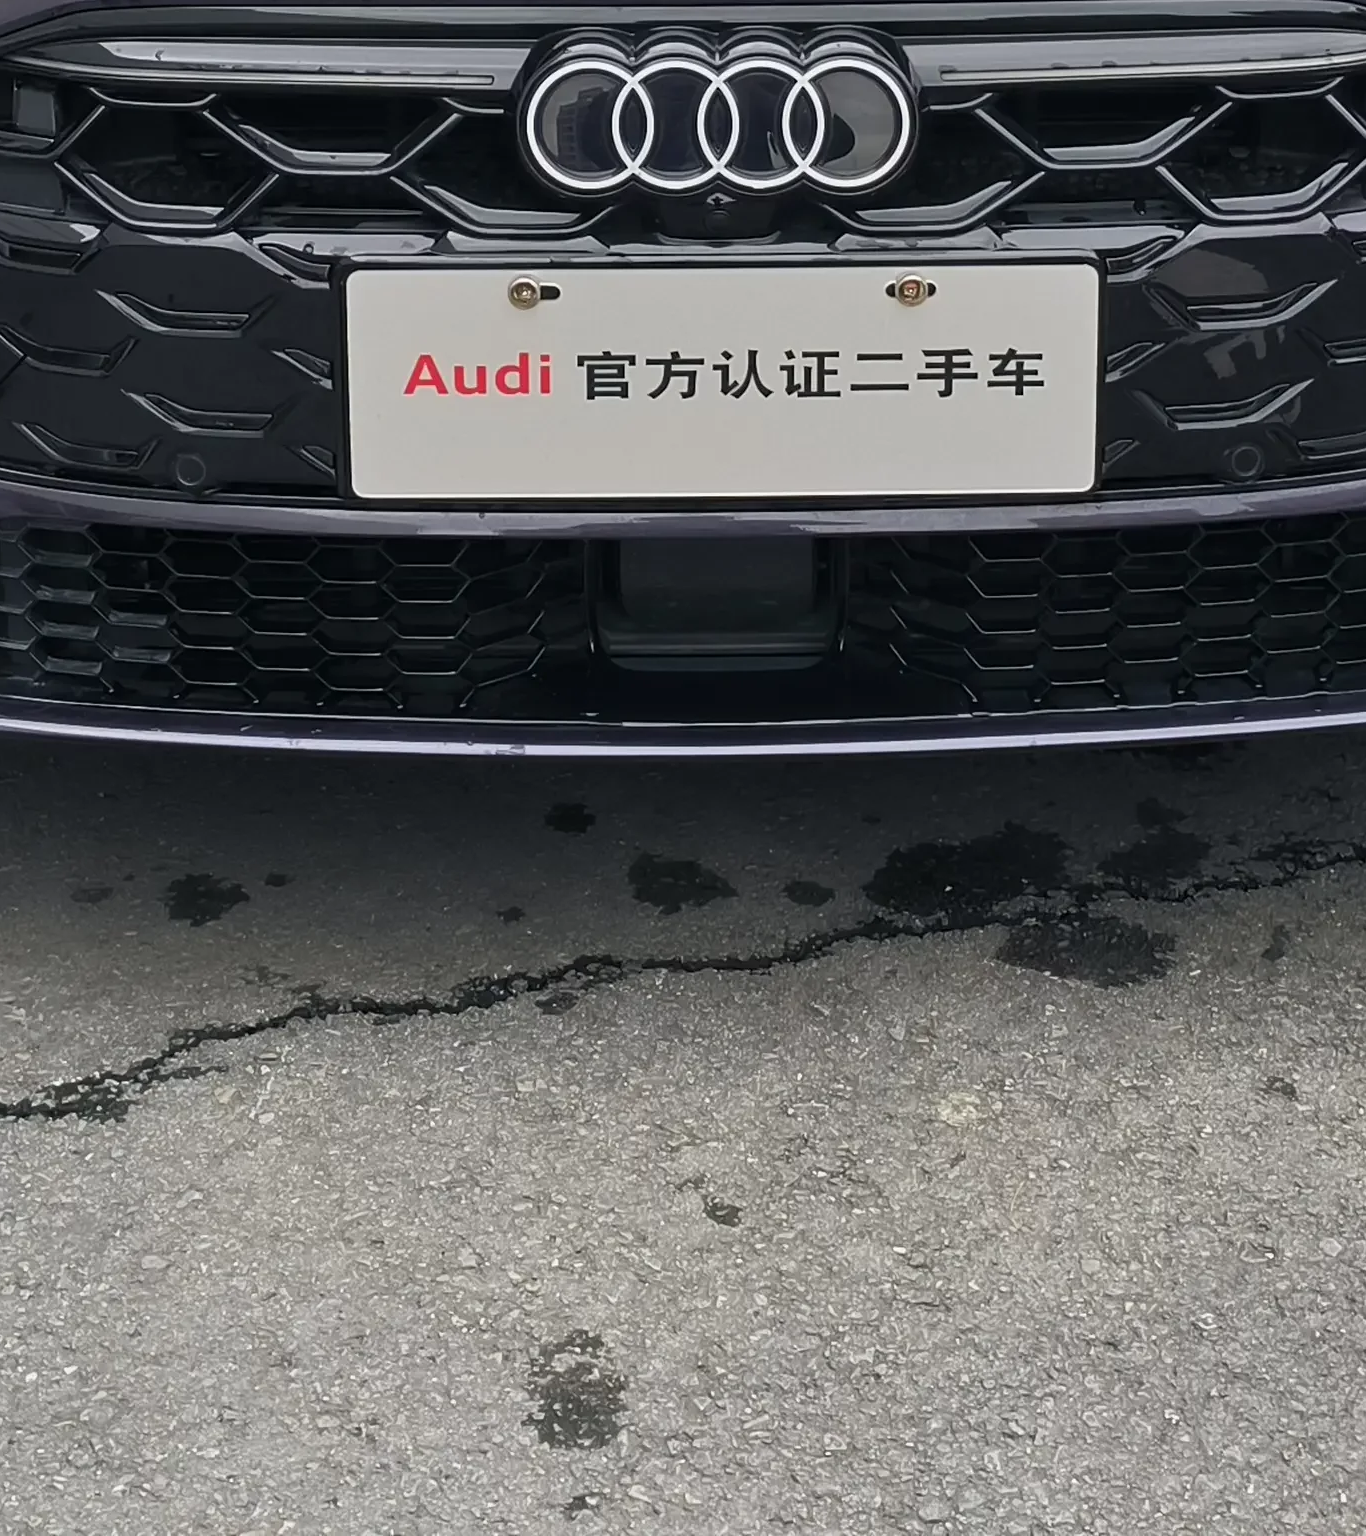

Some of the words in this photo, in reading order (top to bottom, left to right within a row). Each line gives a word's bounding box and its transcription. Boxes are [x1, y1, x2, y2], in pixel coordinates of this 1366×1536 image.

[403, 353, 553, 399] Audi
[576, 348, 1046, 401] 官方认证二手车
